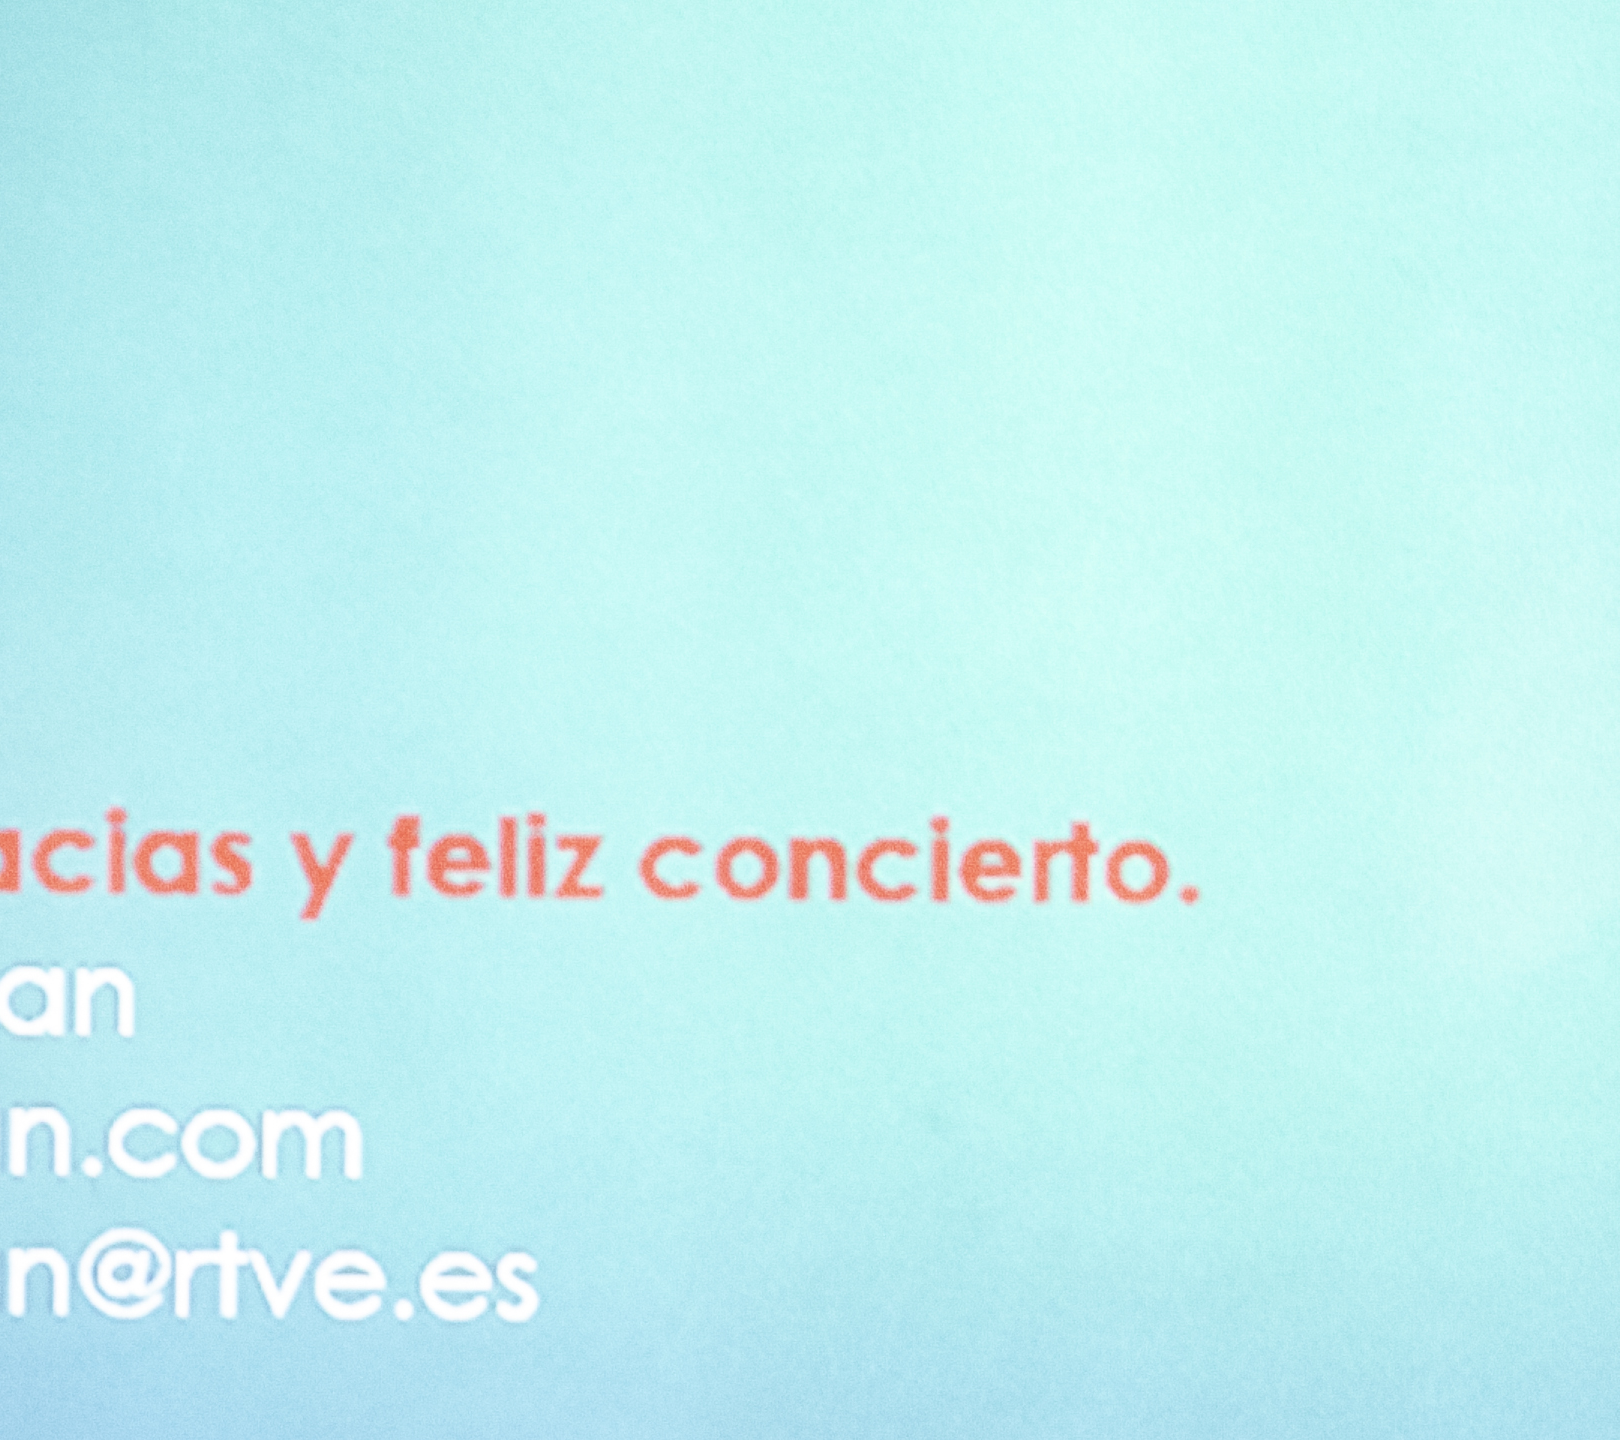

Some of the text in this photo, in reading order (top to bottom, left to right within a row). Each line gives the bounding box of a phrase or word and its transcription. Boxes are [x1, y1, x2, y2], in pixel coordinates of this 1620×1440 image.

[292, 833, 352, 920] y
[388, 813, 602, 900] feliz
[639, 816, 1198, 904] concierto.
